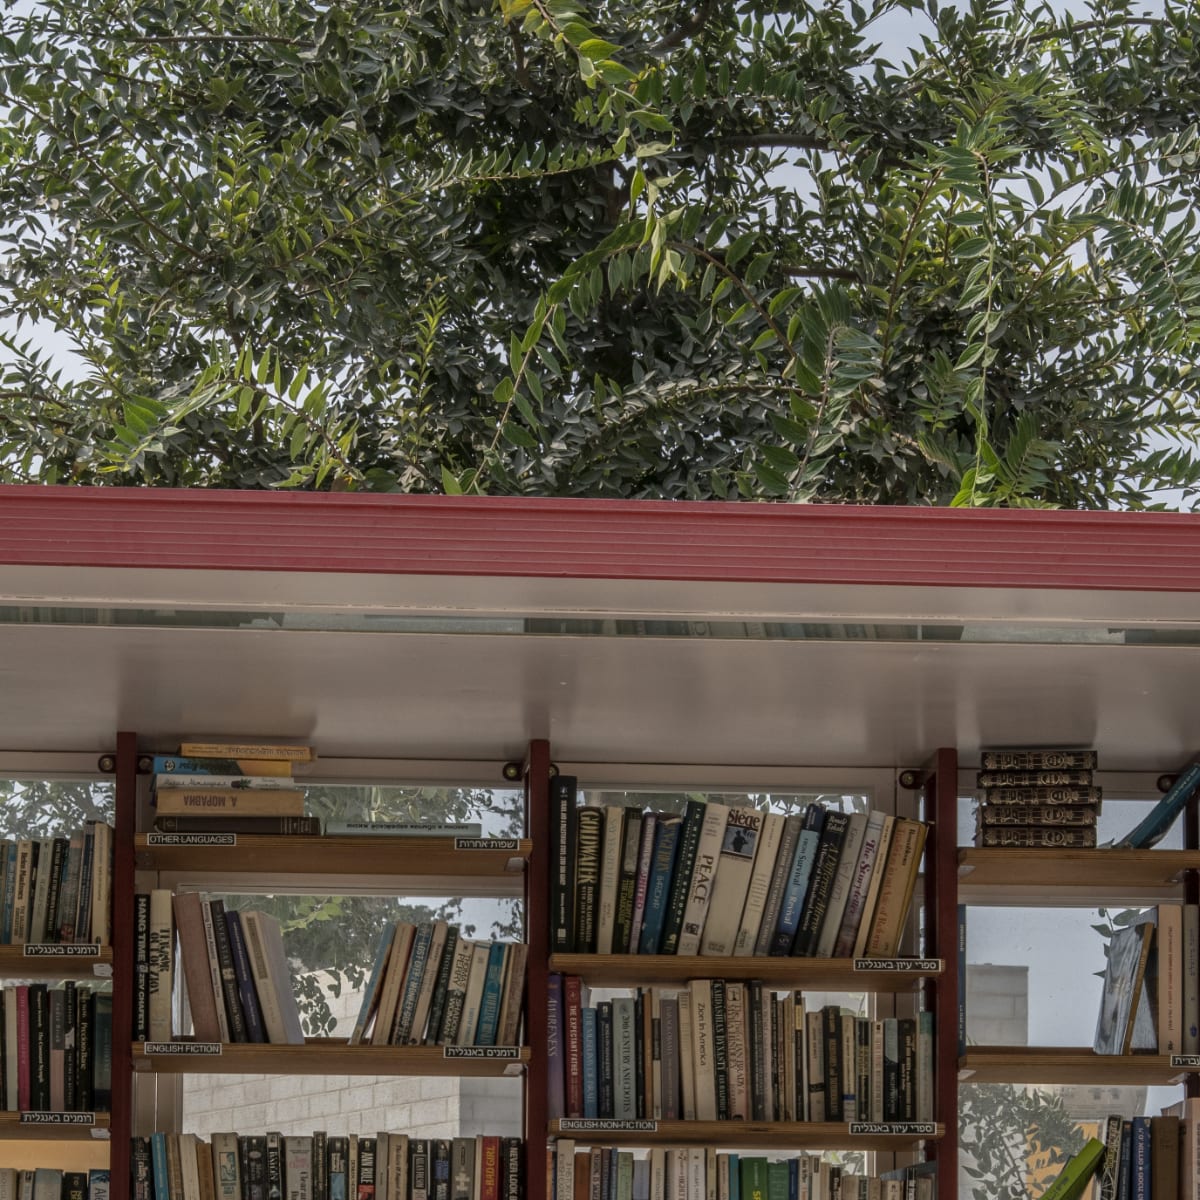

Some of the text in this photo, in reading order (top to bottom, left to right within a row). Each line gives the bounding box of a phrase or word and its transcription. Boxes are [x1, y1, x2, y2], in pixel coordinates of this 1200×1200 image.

[183, 796, 226, 806] МОРАВИА
[728, 809, 760, 828] Siege
[149, 835, 233, 844] OTHER LANGUAGES
[459, 840, 518, 848] שפות אחרות
[578, 810, 600, 884] GOLDWATER
[693, 855, 714, 904] PEACE
[849, 840, 876, 914] The Storyteller
[27, 946, 97, 955] רומנים באנגלית
[855, 960, 936, 970] ספרי עיון באנגלית
[547, 998, 558, 1057] AWARENESS
[622, 1016, 630, 1030] 20th
[570, 1017, 578, 1052] EXPECTANT
[146, 1044, 220, 1053] ENGLISH FICTION
[445, 1048, 516, 1057] רומנים באנגלית
[622, 1031, 630, 1065] CENTURY
[23, 1114, 92, 1122] רומנים באנגלית
[562, 1120, 654, 1130] ENGLISH NON-FICTION
[853, 1123, 934, 1132] ספרי עיון באנגלית
[510, 1147, 518, 1172] NEVER
[361, 1152, 374, 1184] ANN RULE
[509, 1174, 518, 1194] LOOK
